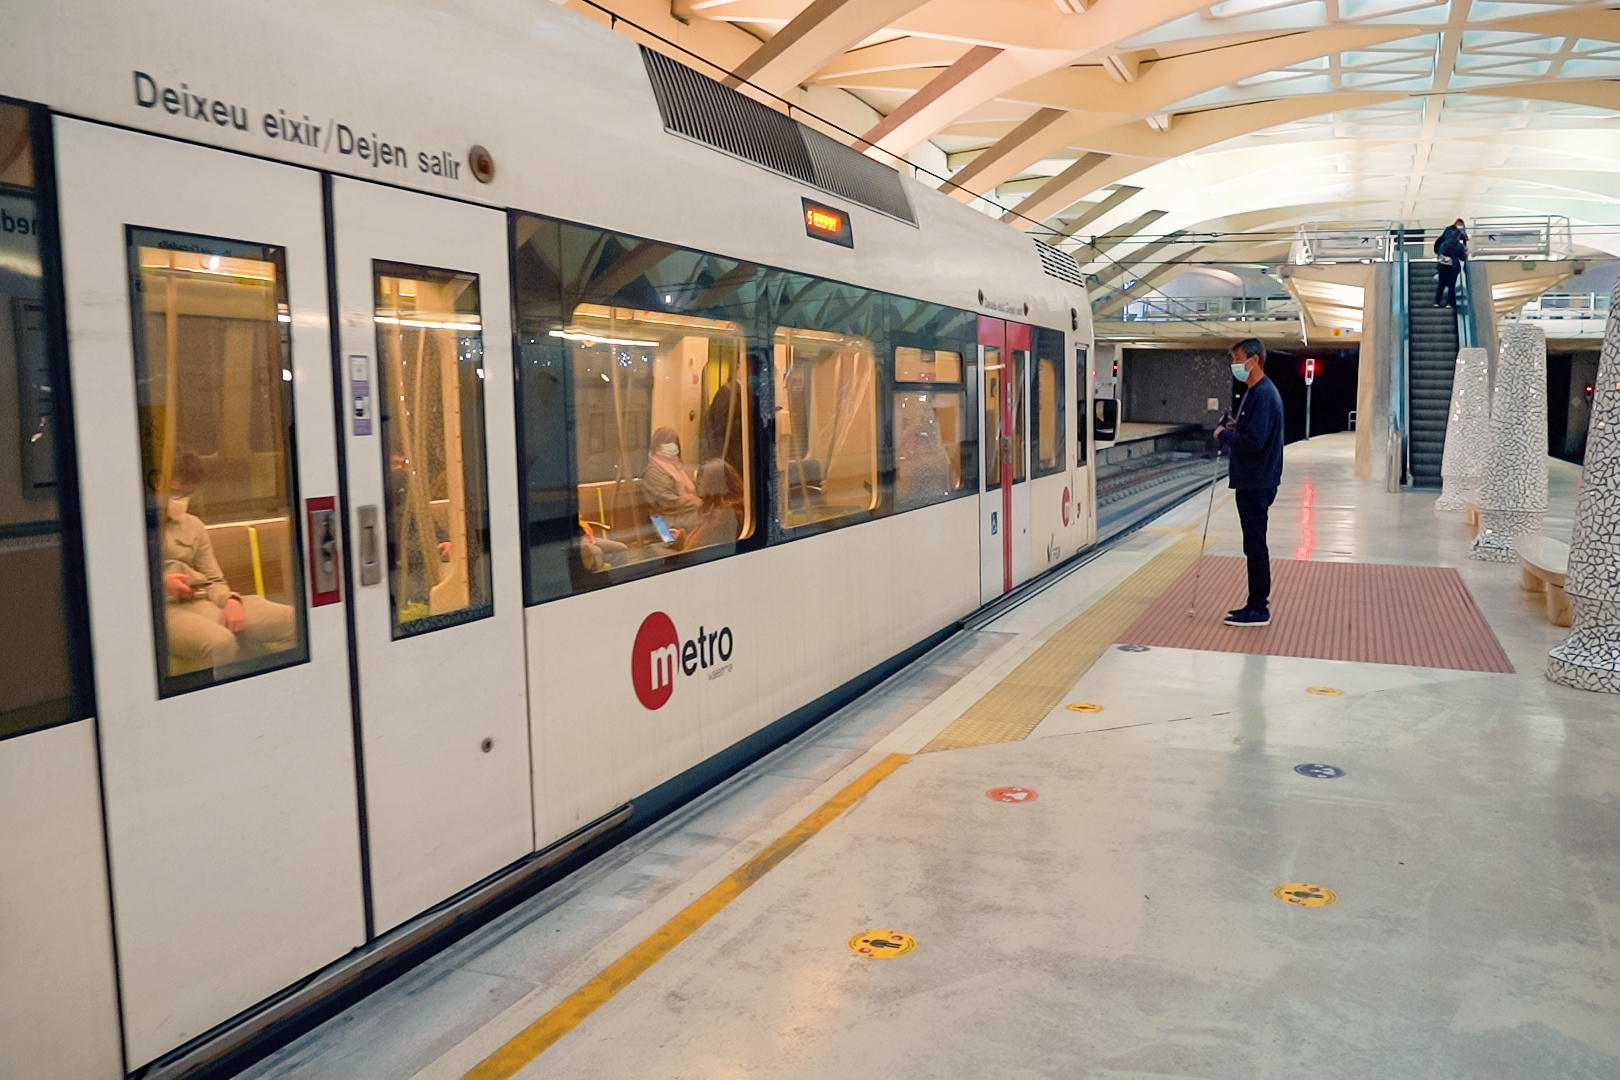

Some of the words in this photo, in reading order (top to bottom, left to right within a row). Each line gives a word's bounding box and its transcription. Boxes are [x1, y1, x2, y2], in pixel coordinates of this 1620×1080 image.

[132, 69, 249, 132] Deixeu
[417, 149, 461, 180] salir
[649, 625, 734, 692] metro
